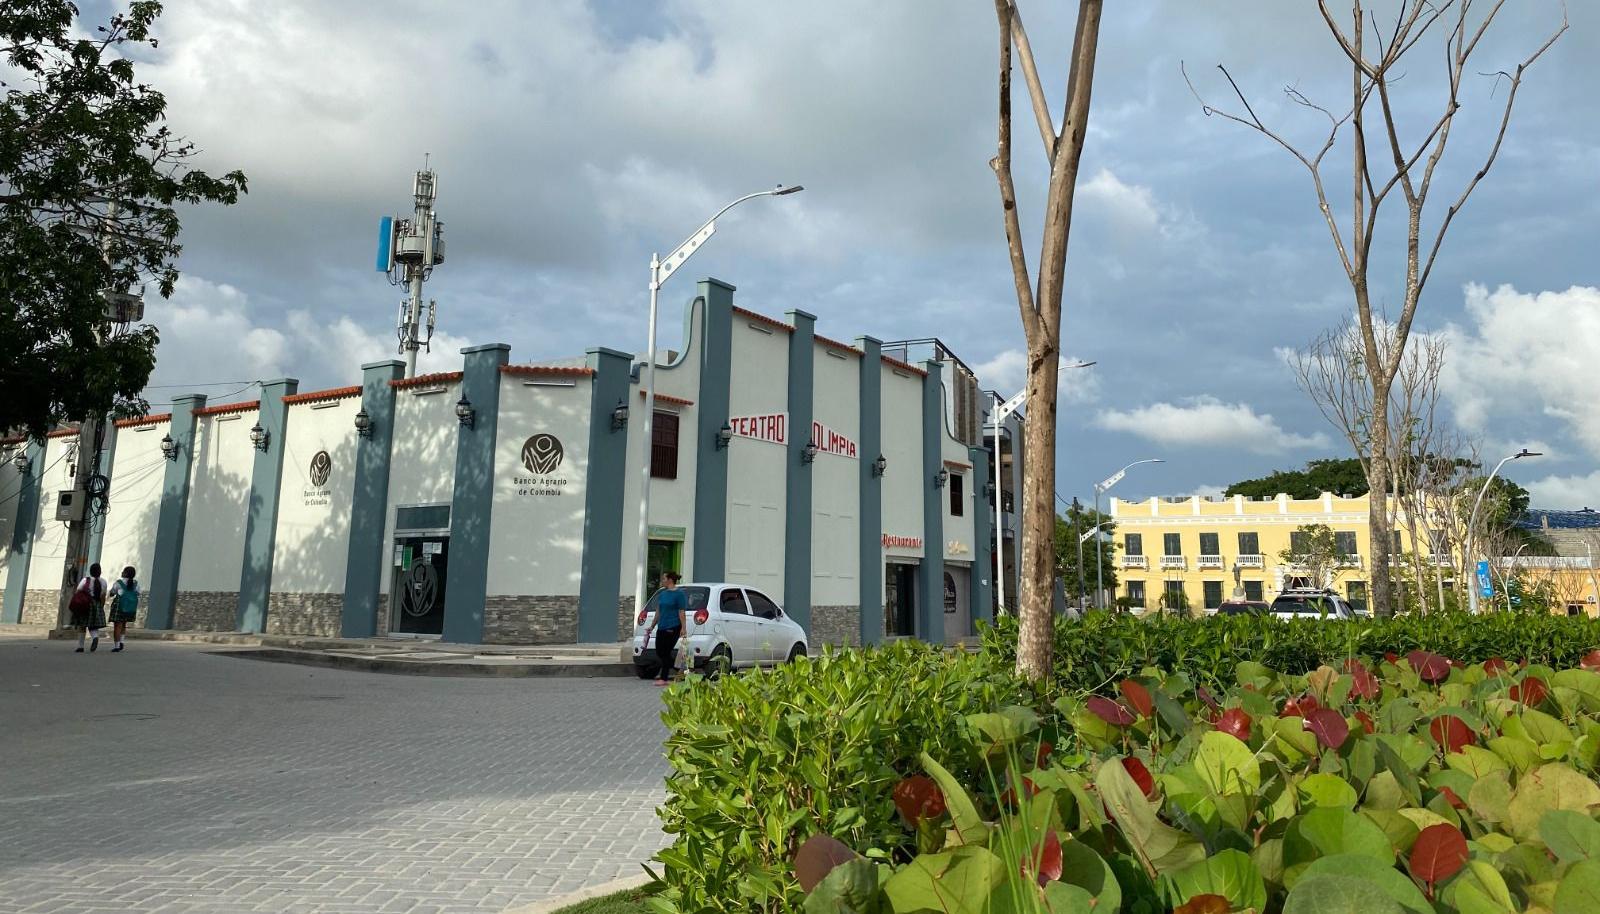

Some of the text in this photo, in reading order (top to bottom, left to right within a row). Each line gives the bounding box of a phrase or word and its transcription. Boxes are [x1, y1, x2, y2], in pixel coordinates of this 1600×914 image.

[730, 414, 857, 457] TEATRO OLIMPIA
[513, 477, 567, 487] Banco Agrario
[518, 488, 561, 496] de Colombia
[882, 533, 923, 550] Restaurante
